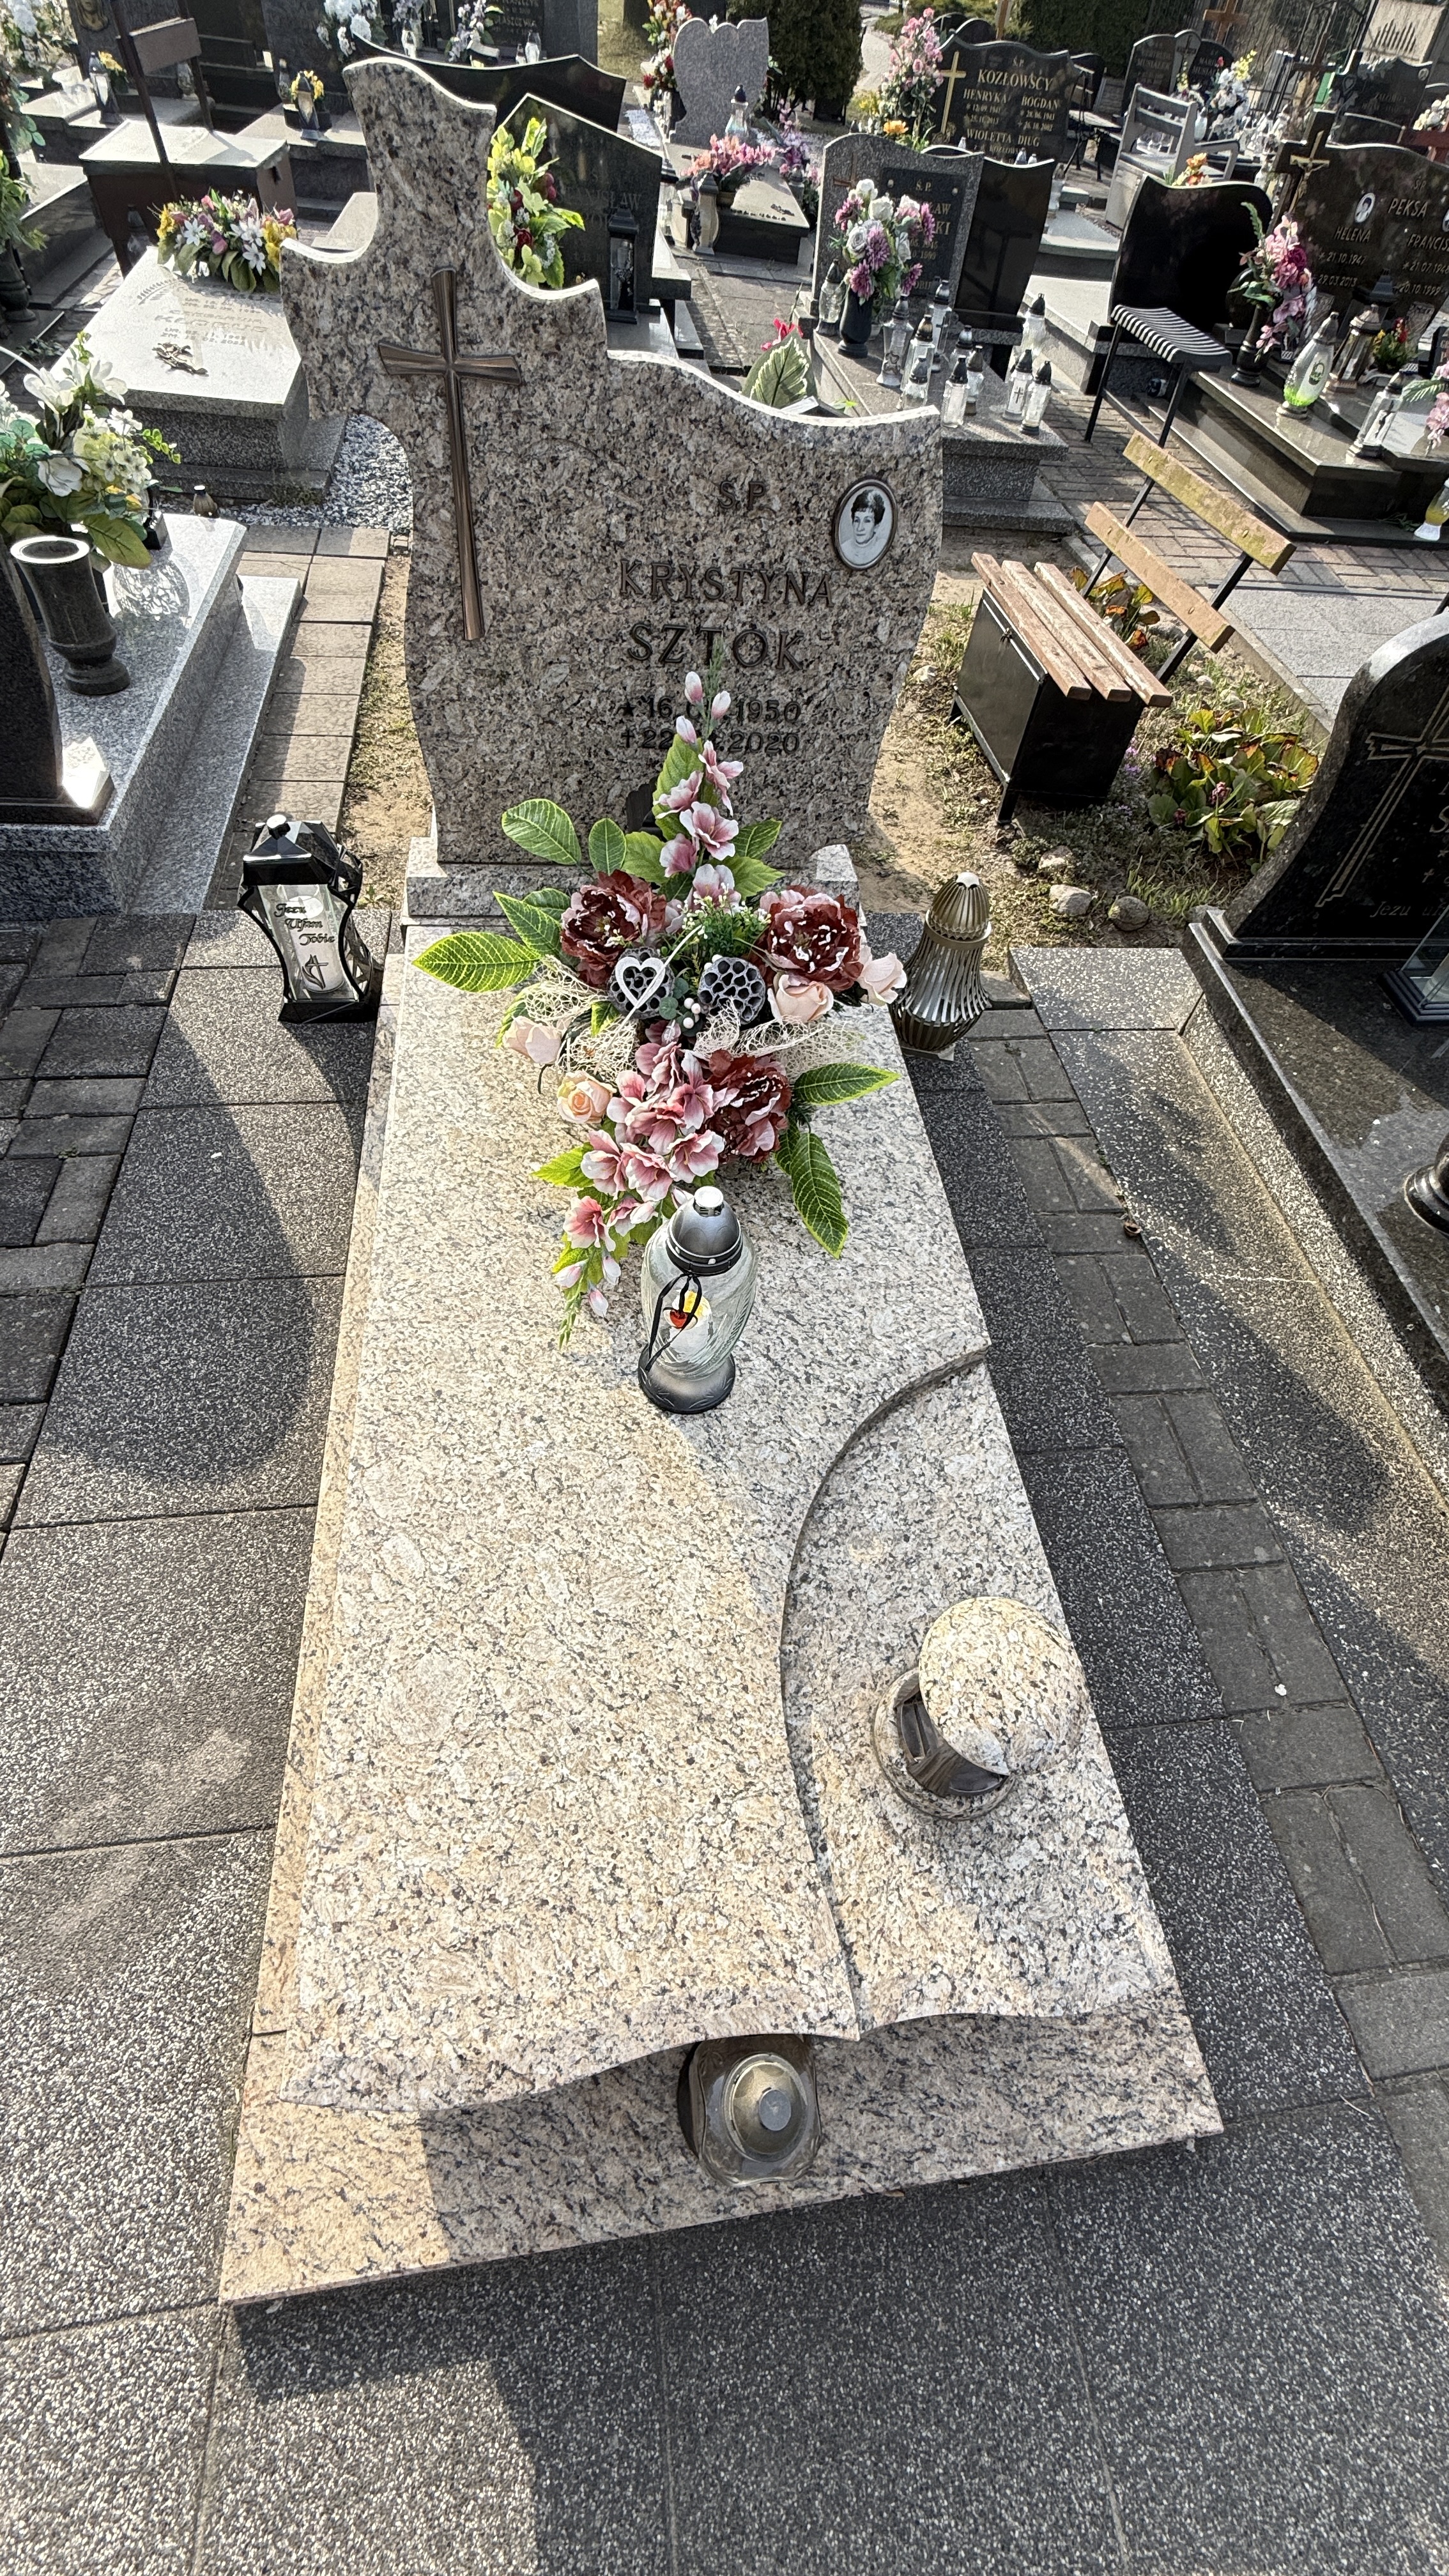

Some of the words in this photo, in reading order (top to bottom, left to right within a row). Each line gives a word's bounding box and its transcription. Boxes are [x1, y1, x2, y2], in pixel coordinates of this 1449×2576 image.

[963, 88, 1008, 103] HENRYKA
[1021, 96, 1059, 110] BOGDAN
[967, 128, 1012, 143] WIOLETTA
[1388, 197, 1429, 218] PEKSA
[1334, 226, 1371, 243] HELENA
[620, 560, 834, 607] KRYSTYNA
[298, 933, 335, 946] Tobie
